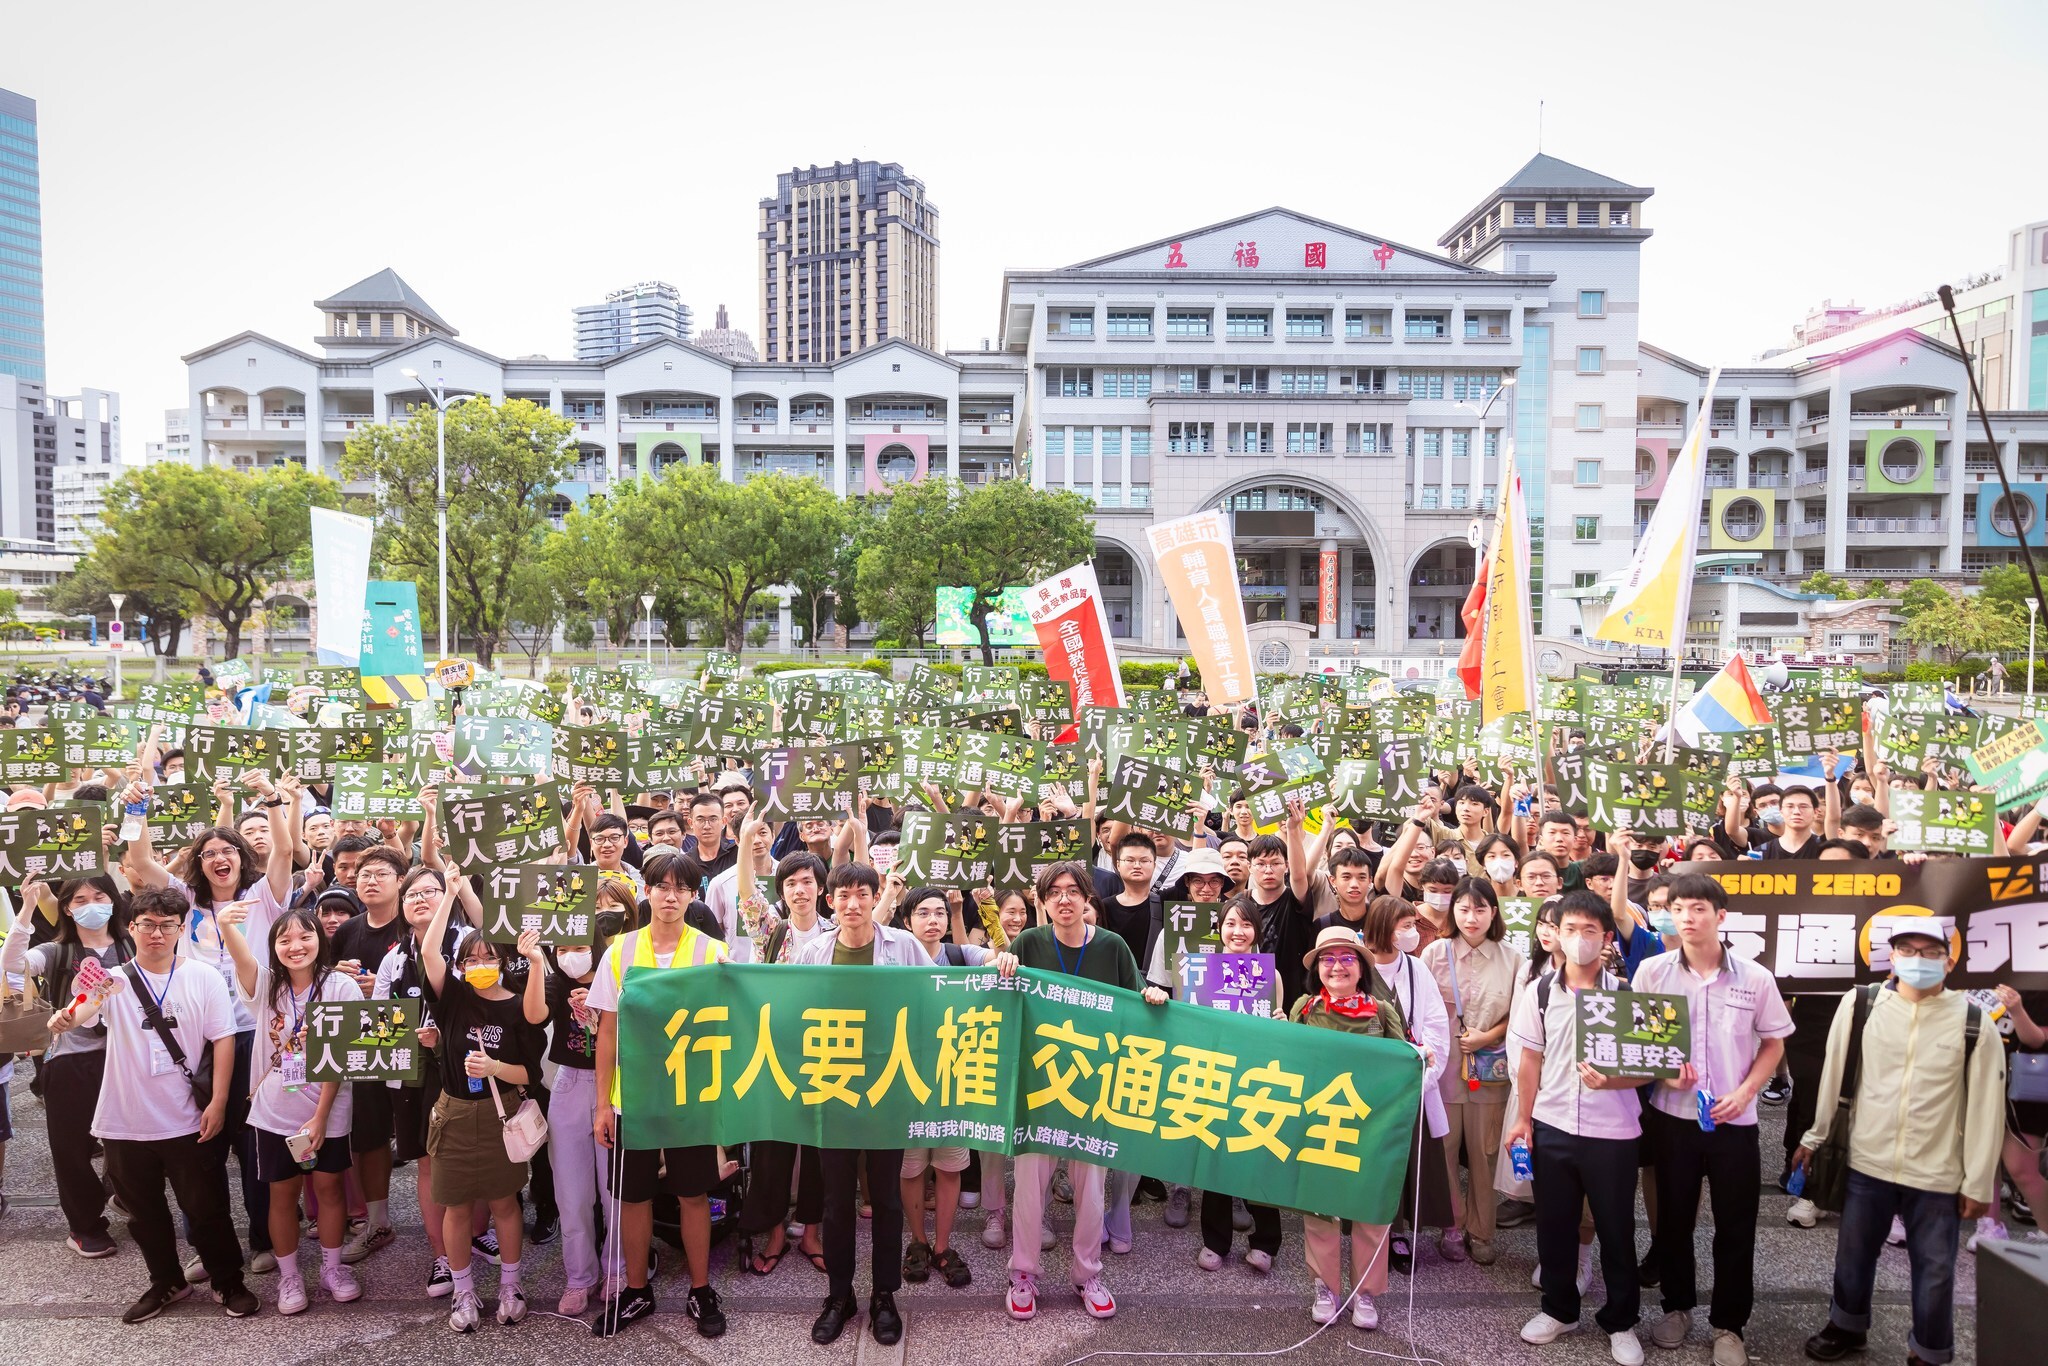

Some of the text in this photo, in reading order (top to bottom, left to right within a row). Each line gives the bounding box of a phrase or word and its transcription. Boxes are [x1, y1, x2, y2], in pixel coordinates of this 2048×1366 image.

[1151, 516, 1219, 553] 高雄市
[1031, 588, 1087, 622] 兒童受教品質
[402, 608, 417, 657] 電氣設備
[1181, 549, 1240, 698] 輔育人員職業工會
[1635, 627, 1665, 640] KTA
[441, 662, 466, 677] 請支援
[966, 667, 983, 700] 行人
[136, 685, 159, 720] 交通
[516, 687, 537, 720] 交通
[983, 689, 1016, 701] 要人權
[1272, 691, 1289, 720] 行人
[1289, 704, 1319, 719] 要人權
[1892, 683, 1909, 713] 行人
[1909, 702, 1942, 714] 要人權
[154, 709, 191, 724] 要安全
[694, 699, 723, 751] 行人
[789, 690, 813, 734] 行人
[1036, 708, 1070, 720] 要人權
[1782, 705, 1812, 752] 交通
[63, 721, 87, 763] 交通
[459, 718, 489, 769] 行人
[1085, 708, 1106, 754] 行人
[1588, 716, 1605, 748] 行人
[1813, 731, 1860, 749] 要安全
[6, 762, 61, 778] 要安全
[88, 749, 134, 763] 要安全
[190, 728, 215, 784] 行人
[295, 730, 322, 783] 交通
[409, 732, 432, 787] 行人
[490, 752, 547, 768] 要人權
[552, 727, 571, 780] 交通
[920, 761, 954, 778] 要安
[958, 733, 990, 786] 交通
[1727, 759, 1772, 774] 要安全
[572, 764, 623, 782] 要安全
[647, 767, 694, 786] 要人權
[760, 752, 789, 814] 行人
[858, 773, 900, 794] 要人權
[985, 769, 1034, 794] 要安全
[1112, 759, 1149, 819] 行人
[1338, 762, 1367, 814] 行人
[1384, 743, 1417, 802] 行人
[1556, 754, 1588, 808] 行人
[338, 766, 368, 815] 交通
[368, 797, 423, 815] 要安全
[792, 791, 852, 812] 要人權
[1038, 780, 1085, 799] 要權
[1242, 761, 1285, 820] 交通
[1588, 762, 1613, 827] 行人
[148, 821, 206, 842] 要人權
[1139, 802, 1191, 832] 要人權
[1613, 808, 1679, 829] 要人權
[1895, 793, 1924, 845] 交通
[451, 802, 493, 868] 行人
[494, 826, 560, 862] 要人權
[901, 814, 932, 880] 行人
[1925, 826, 1989, 848] 要安全
[24, 851, 97, 876] 要人權
[929, 859, 989, 881] 要人權
[998, 826, 1029, 884] 行人
[1812, 873, 1902, 896] ZERO
[489, 867, 521, 937] 行人
[520, 914, 589, 937] 要人權
[1503, 899, 1532, 955] 交通
[931, 973, 1114, 1012] 下一代學生行人路權聯盟
[312, 1005, 344, 1074] 行人
[1583, 992, 1618, 1068] 交通
[347, 1048, 411, 1071] 要人權
[664, 1002, 1003, 1108] 行人要人權
[1621, 1043, 1686, 1069] 要安全
[1026, 1020, 1372, 1173] 交通要安全
[908, 1120, 1005, 1143] 捍衛我們的路
[1013, 1125, 1119, 1158] 行人路權大遊行
